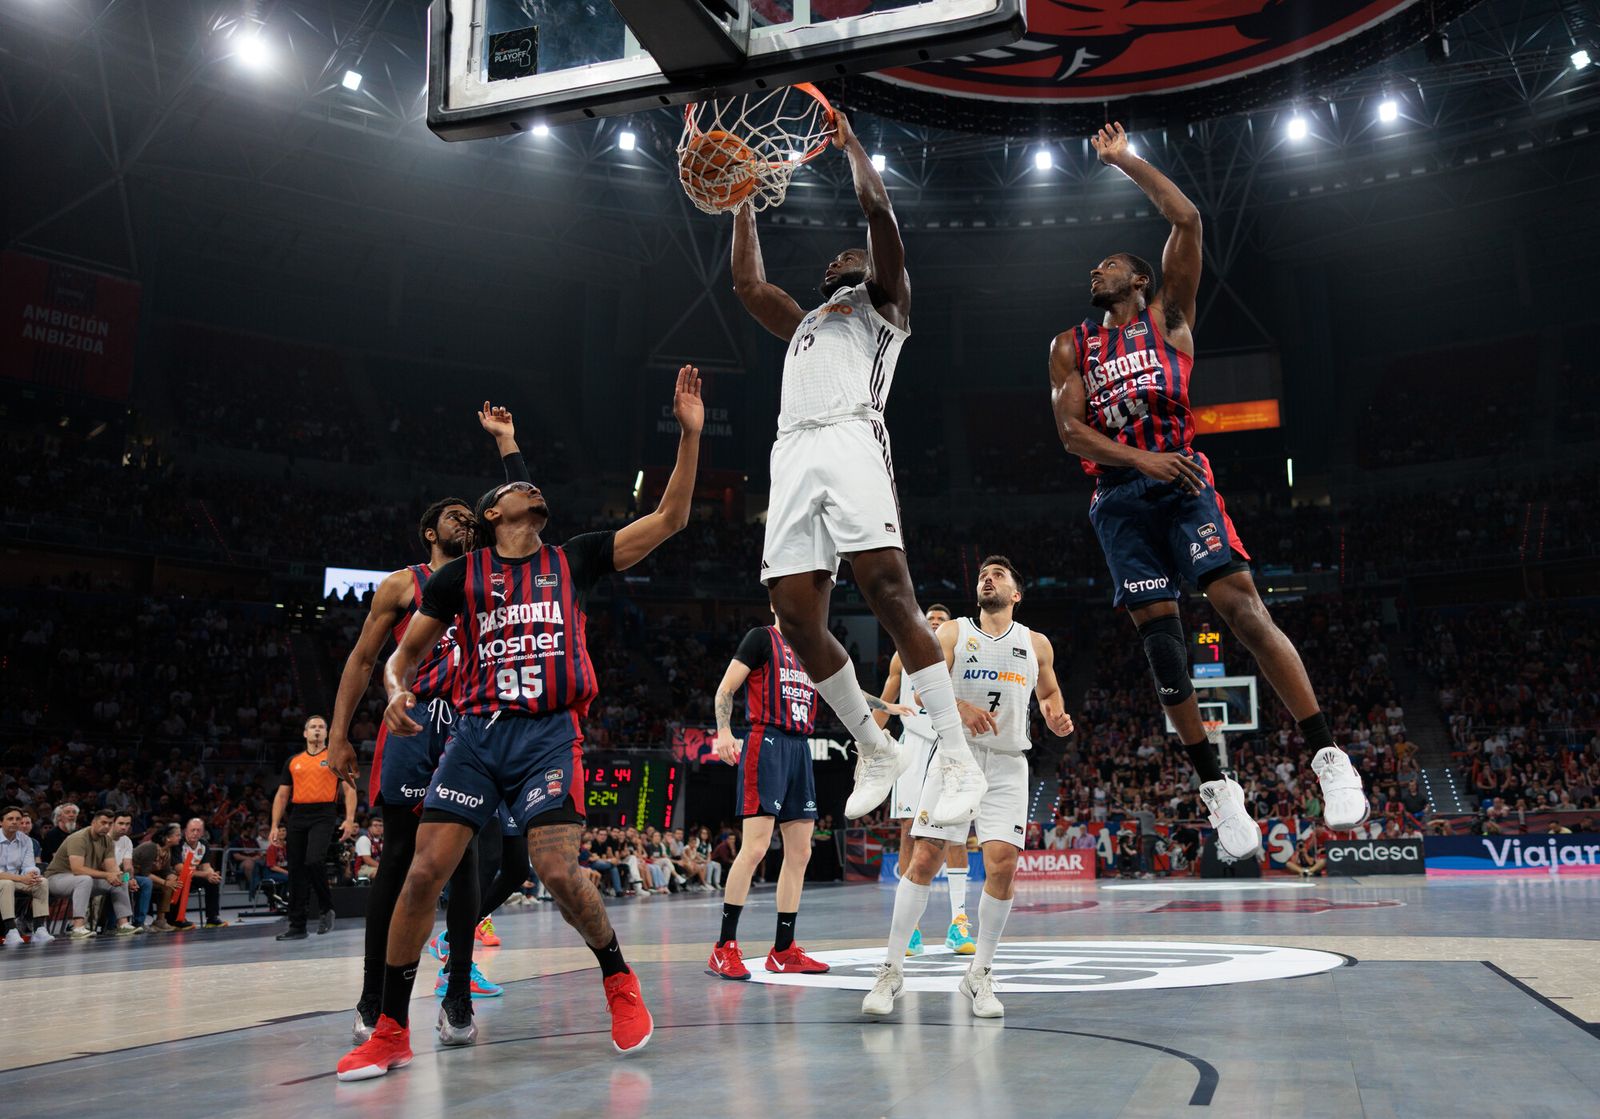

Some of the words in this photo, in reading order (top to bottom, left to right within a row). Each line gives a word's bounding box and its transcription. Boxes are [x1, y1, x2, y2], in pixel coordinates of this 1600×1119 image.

[494, 50, 526, 63] PLAYOFF
[22, 303, 110, 337] AMBICIÓN
[477, 601, 564, 637] BASKONIA
[478, 632, 564, 660] kosner
[1208, 644, 1219, 661] 7
[497, 653, 537, 664] Climatización
[538, 650, 564, 658] eficiente
[496, 665, 543, 701] 95
[782, 684, 813, 700] kosner
[987, 691, 1001, 712] 7
[791, 702, 809, 724] 99
[588, 791, 618, 806] 2:24
[1328, 842, 1418, 862] endesa
[1482, 838, 1600, 874] Viajar
[1016, 854, 1084, 872] AMBAR
